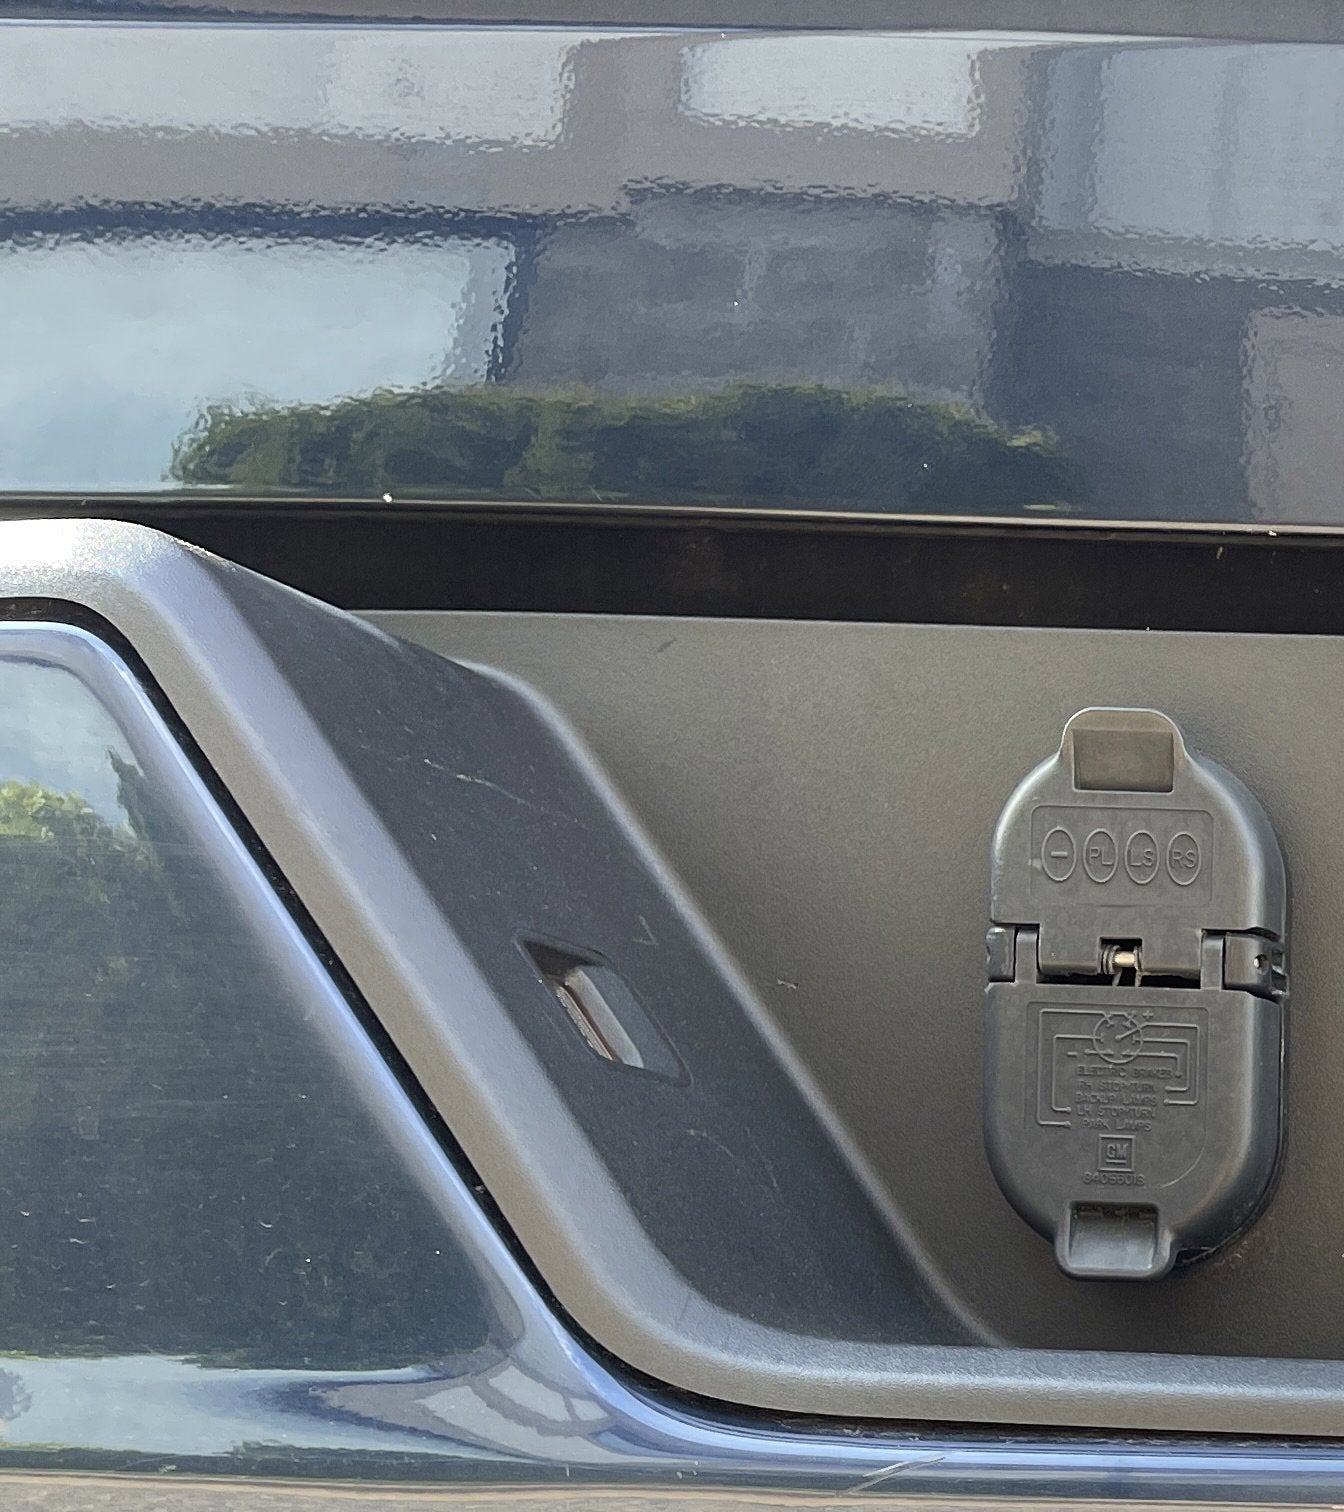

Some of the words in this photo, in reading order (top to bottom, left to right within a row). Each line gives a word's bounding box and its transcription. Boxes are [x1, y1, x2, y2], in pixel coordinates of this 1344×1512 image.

[1089, 846, 1113, 865] PL
[1130, 848, 1154, 867] LS
[1171, 849, 1196, 869] RS
[1106, 1143, 1129, 1159] GM
